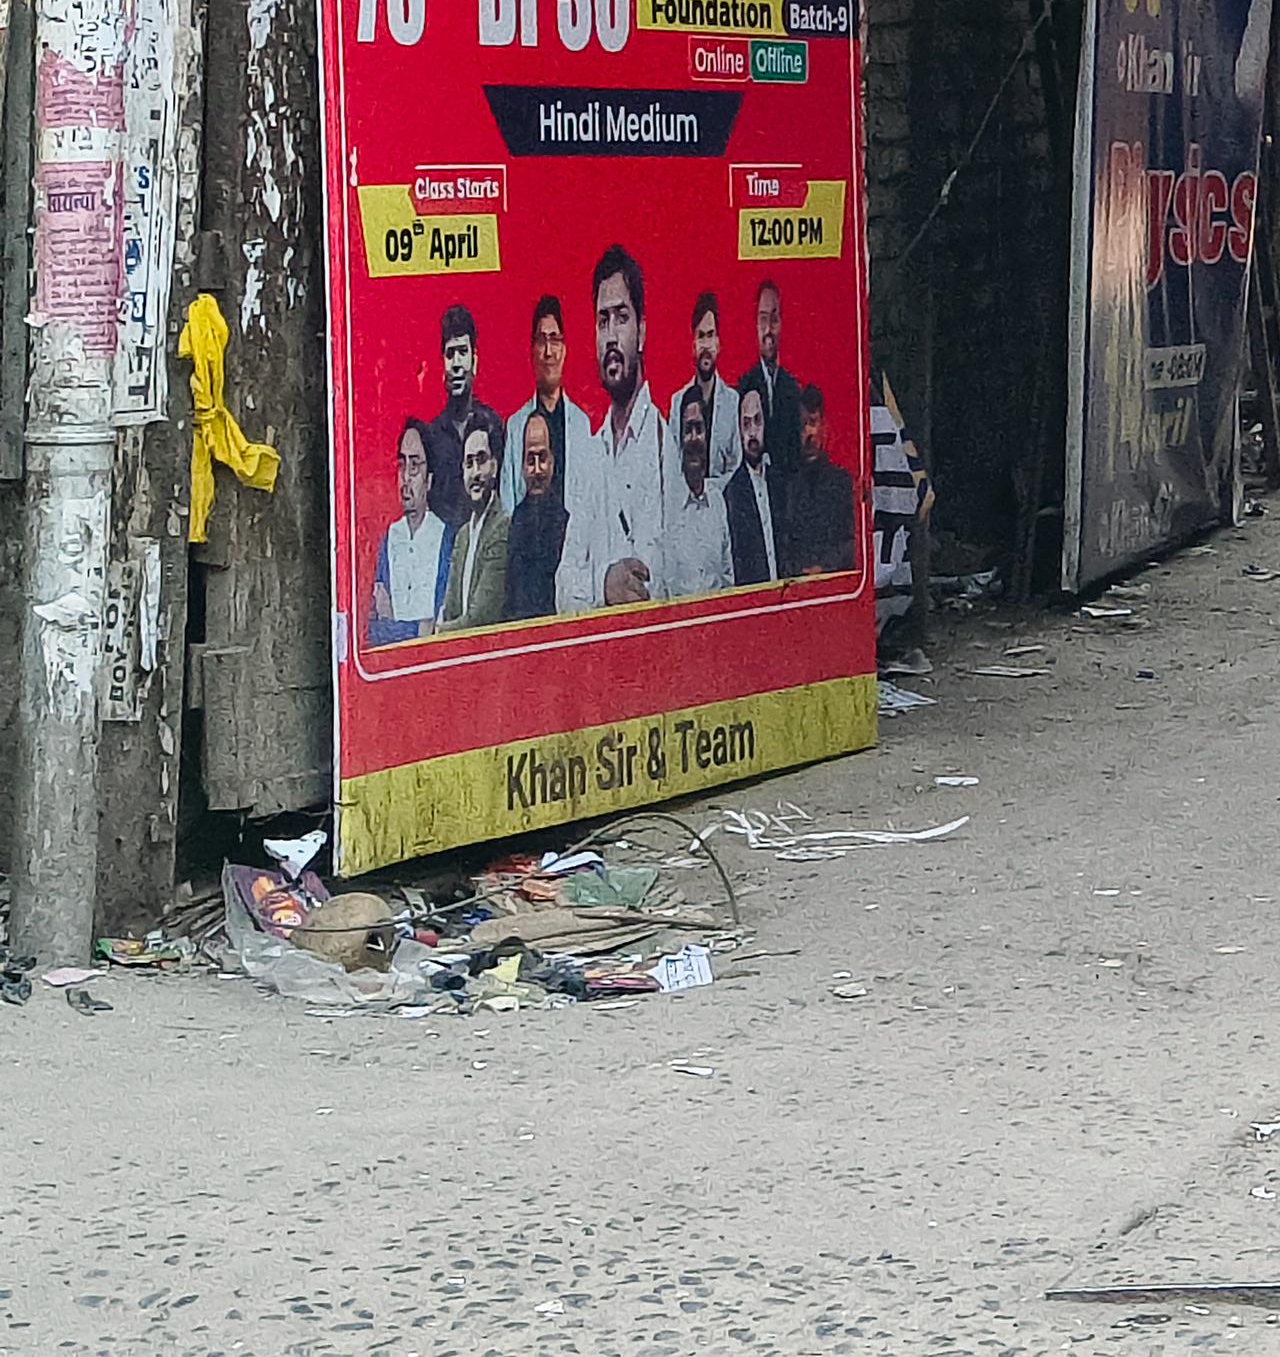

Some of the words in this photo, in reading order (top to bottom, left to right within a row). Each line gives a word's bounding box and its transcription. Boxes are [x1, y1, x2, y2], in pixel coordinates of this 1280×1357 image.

[789, 3, 849, 33] Batch-9
[694, 45, 744, 76] Online
[755, 46, 803, 75] Offline
[538, 103, 600, 143] Hindi
[606, 106, 699, 143] Medium
[415, 176, 455, 200] Class
[456, 177, 500, 200] Starts
[745, 171, 780, 198] Time
[429, 225, 479, 267] April
[749, 217, 795, 248] 12:00
[797, 217, 823, 245] PM
[506, 752, 587, 811] Khan
[595, 735, 634, 790] Sir
[646, 734, 667, 780] &
[673, 719, 755, 775] Team
